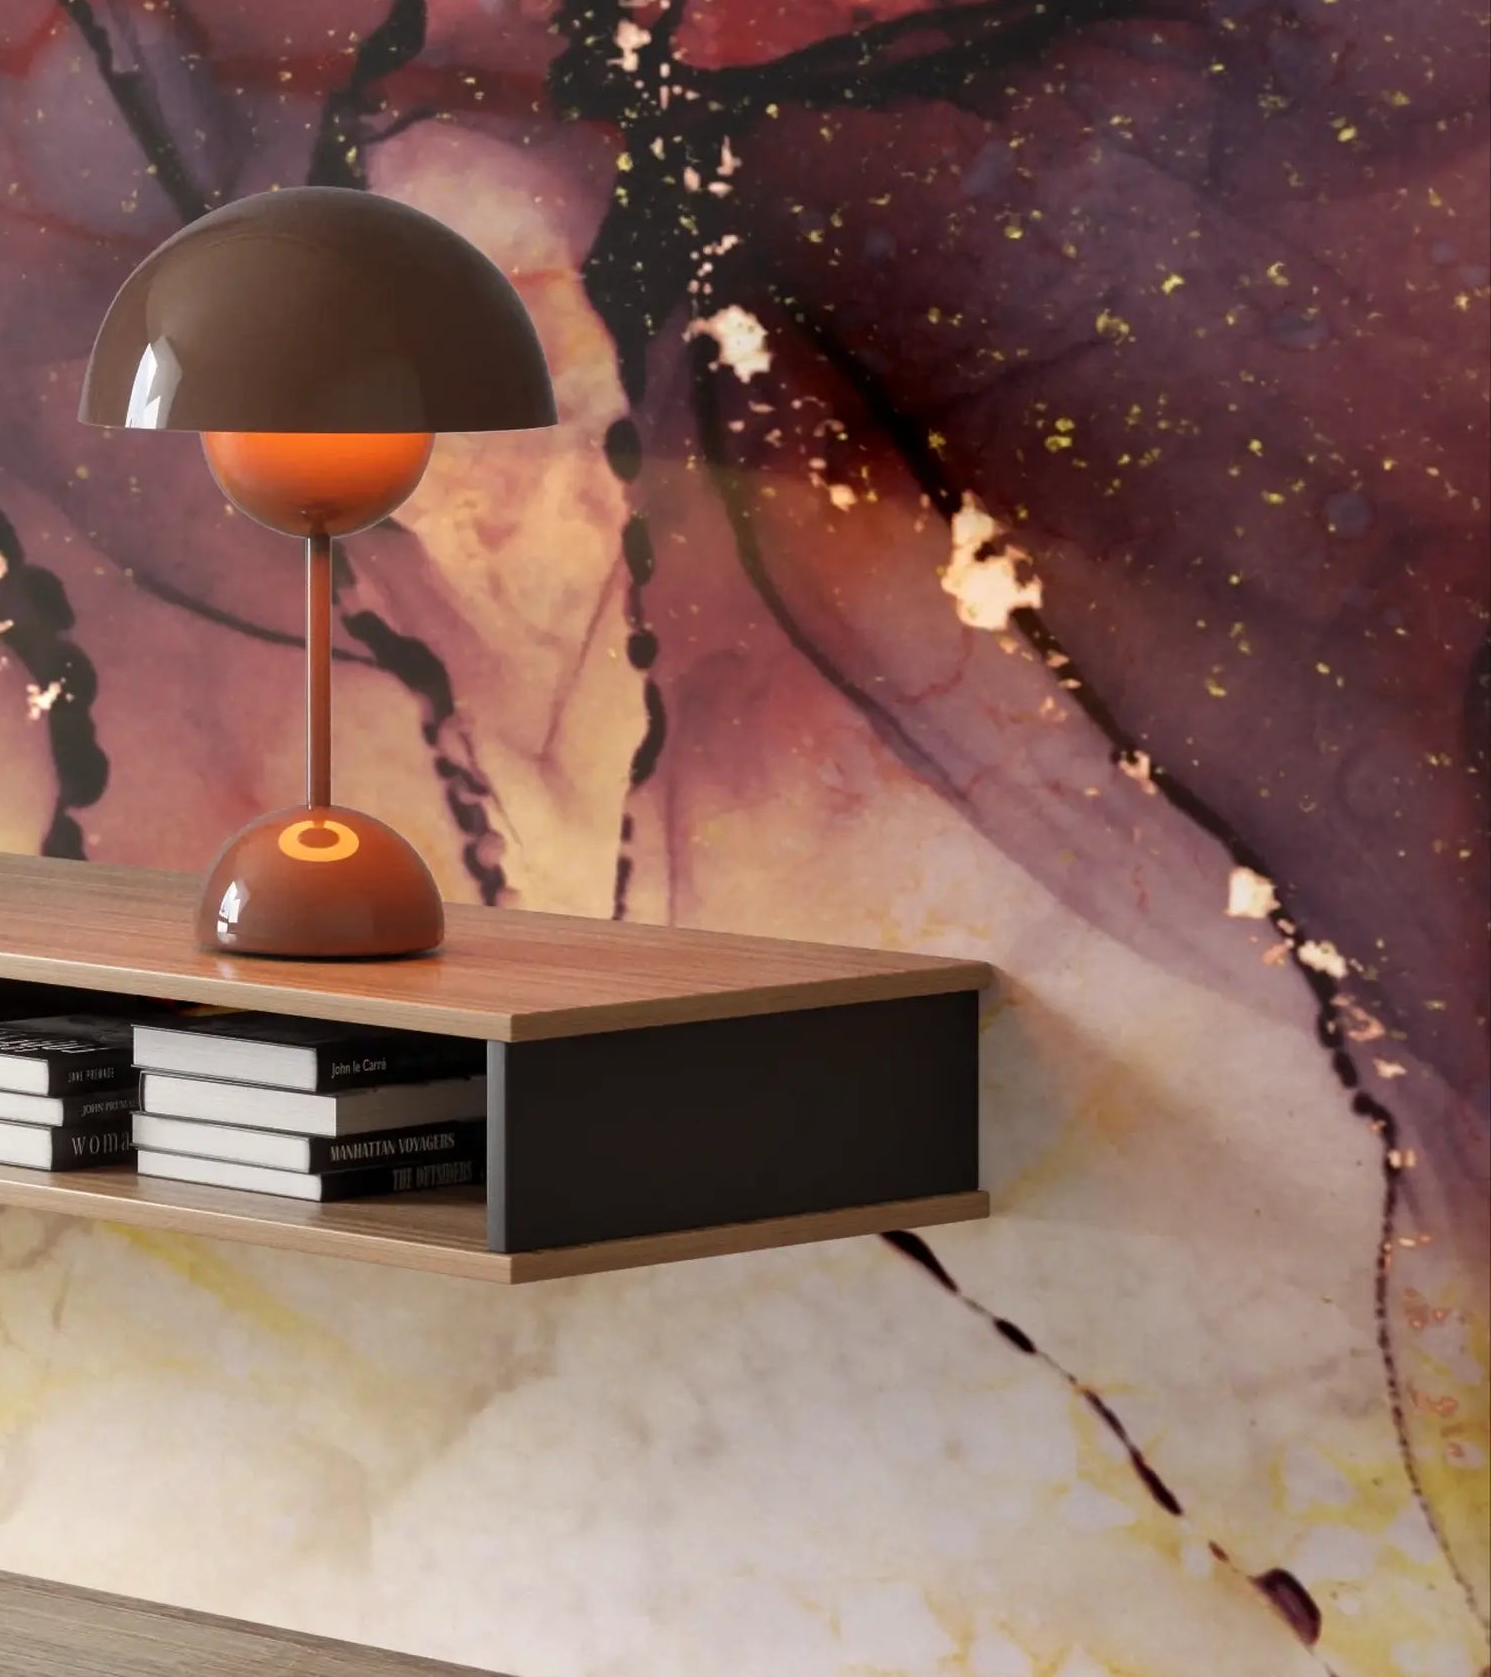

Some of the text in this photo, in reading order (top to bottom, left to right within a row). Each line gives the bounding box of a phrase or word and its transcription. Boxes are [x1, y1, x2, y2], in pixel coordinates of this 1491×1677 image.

[331, 1056, 387, 1079] John le Carré
[81, 1103, 104, 1117] JOHN
[331, 1131, 455, 1161] MANHATTAN VOYAGERS
[392, 1167, 412, 1191] THE
[416, 1160, 472, 1187] OUTSIDERS
